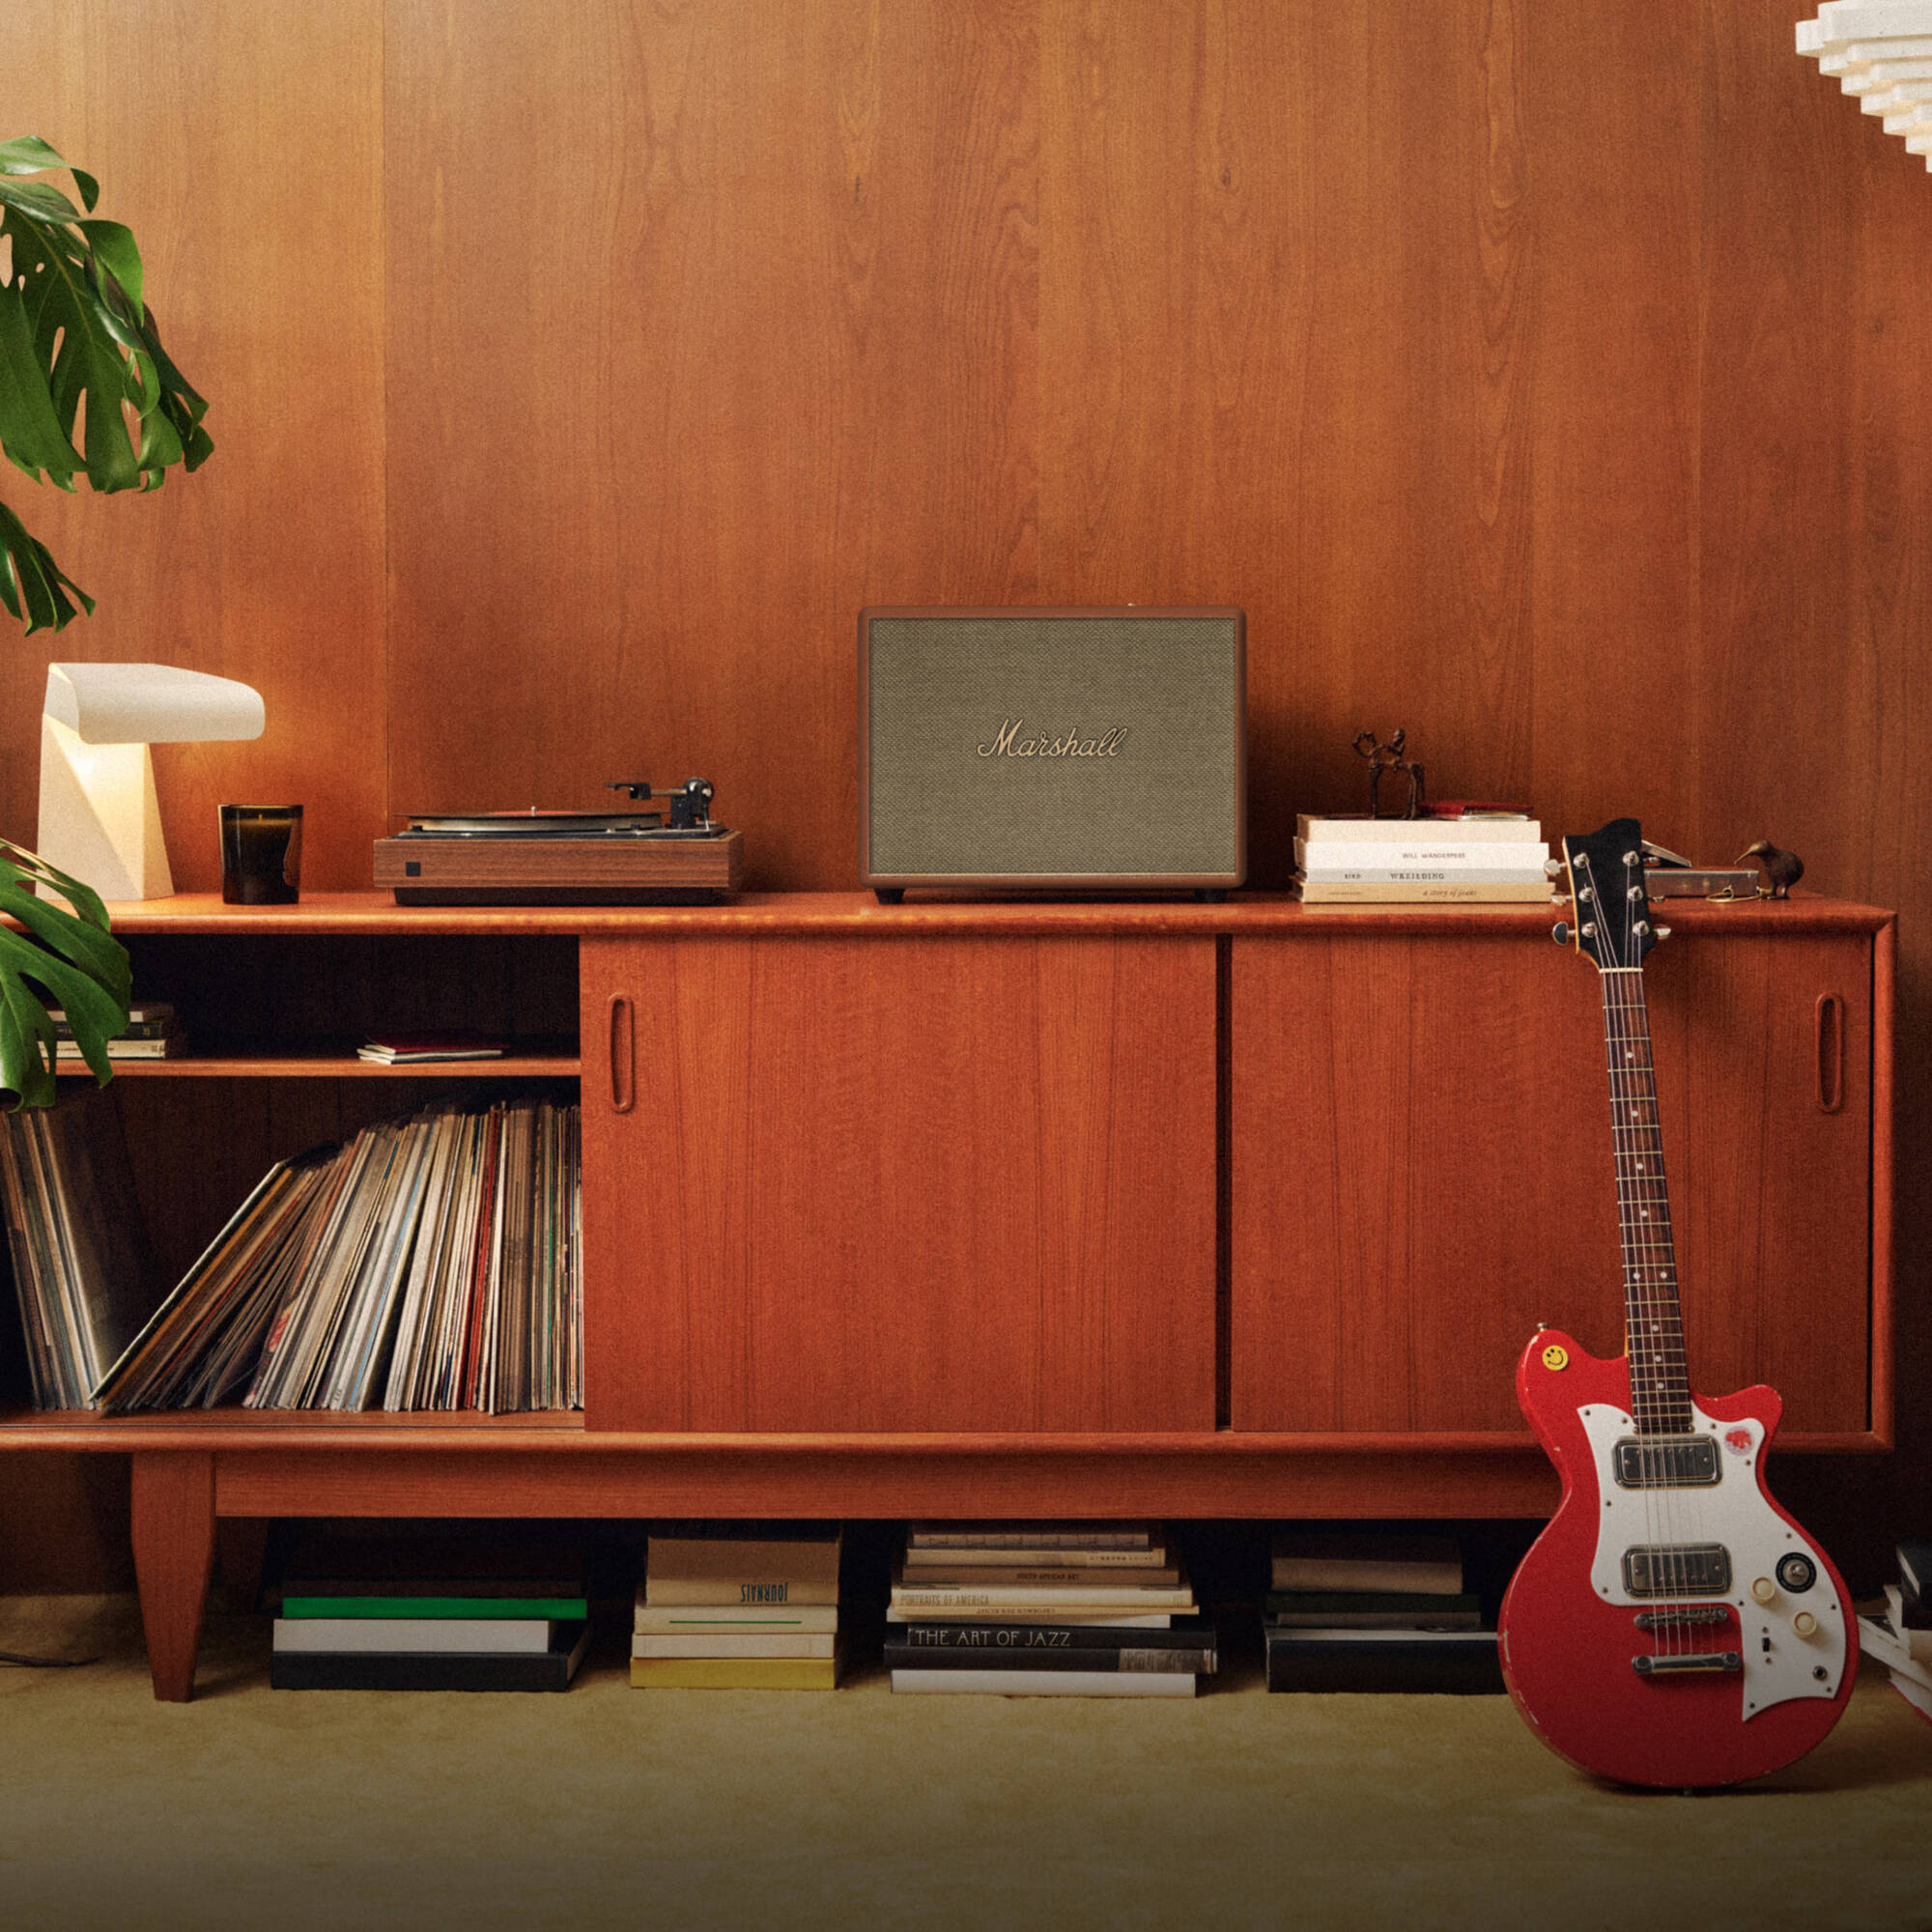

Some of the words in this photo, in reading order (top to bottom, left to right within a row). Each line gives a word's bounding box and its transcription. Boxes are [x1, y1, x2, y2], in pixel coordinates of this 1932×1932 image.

[977, 718, 1128, 757] Marshall
[916, 1630, 949, 1645] THE
[956, 1630, 991, 1646] ART
[996, 1630, 1020, 1646] OF
[1025, 1631, 1070, 1647] JAZZ
